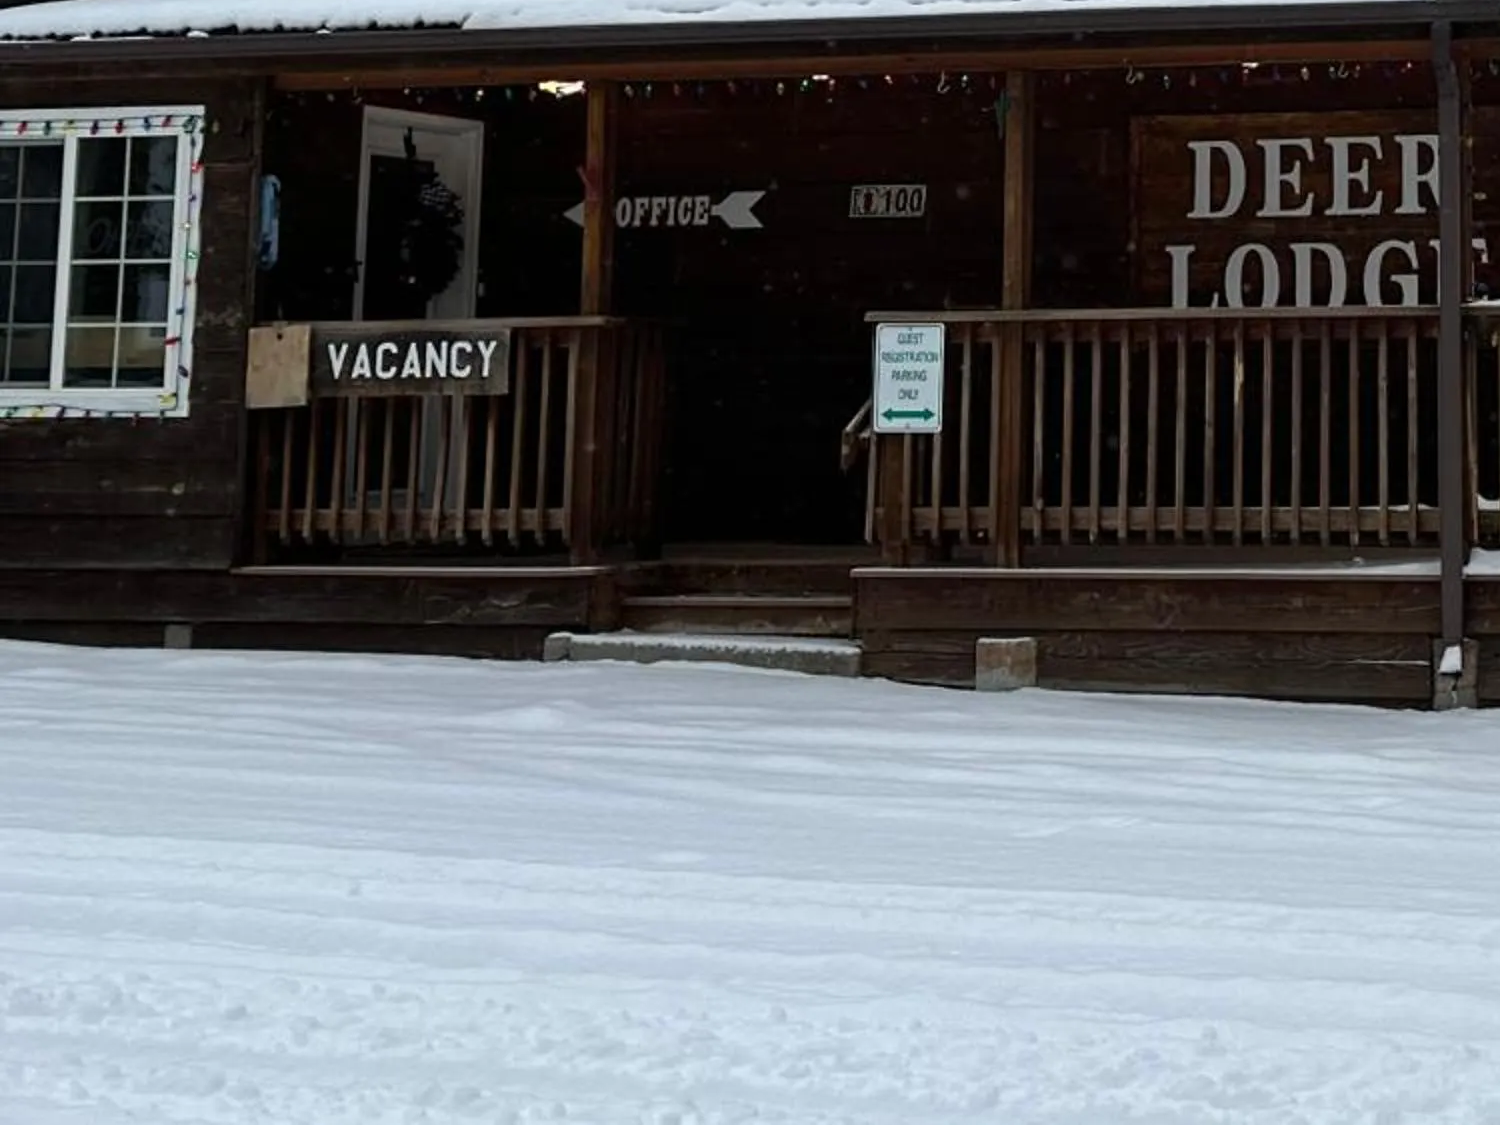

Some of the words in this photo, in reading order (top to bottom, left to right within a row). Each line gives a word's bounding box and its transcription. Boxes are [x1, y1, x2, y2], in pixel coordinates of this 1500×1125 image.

[615, 195, 710, 228] OFFICE
[897, 332, 924, 345] GUEST
[327, 340, 497, 379] VACANCY
[881, 351, 938, 364] REGISTRATION
[891, 370, 927, 382] PARKING
[898, 388, 919, 400] ONLY
